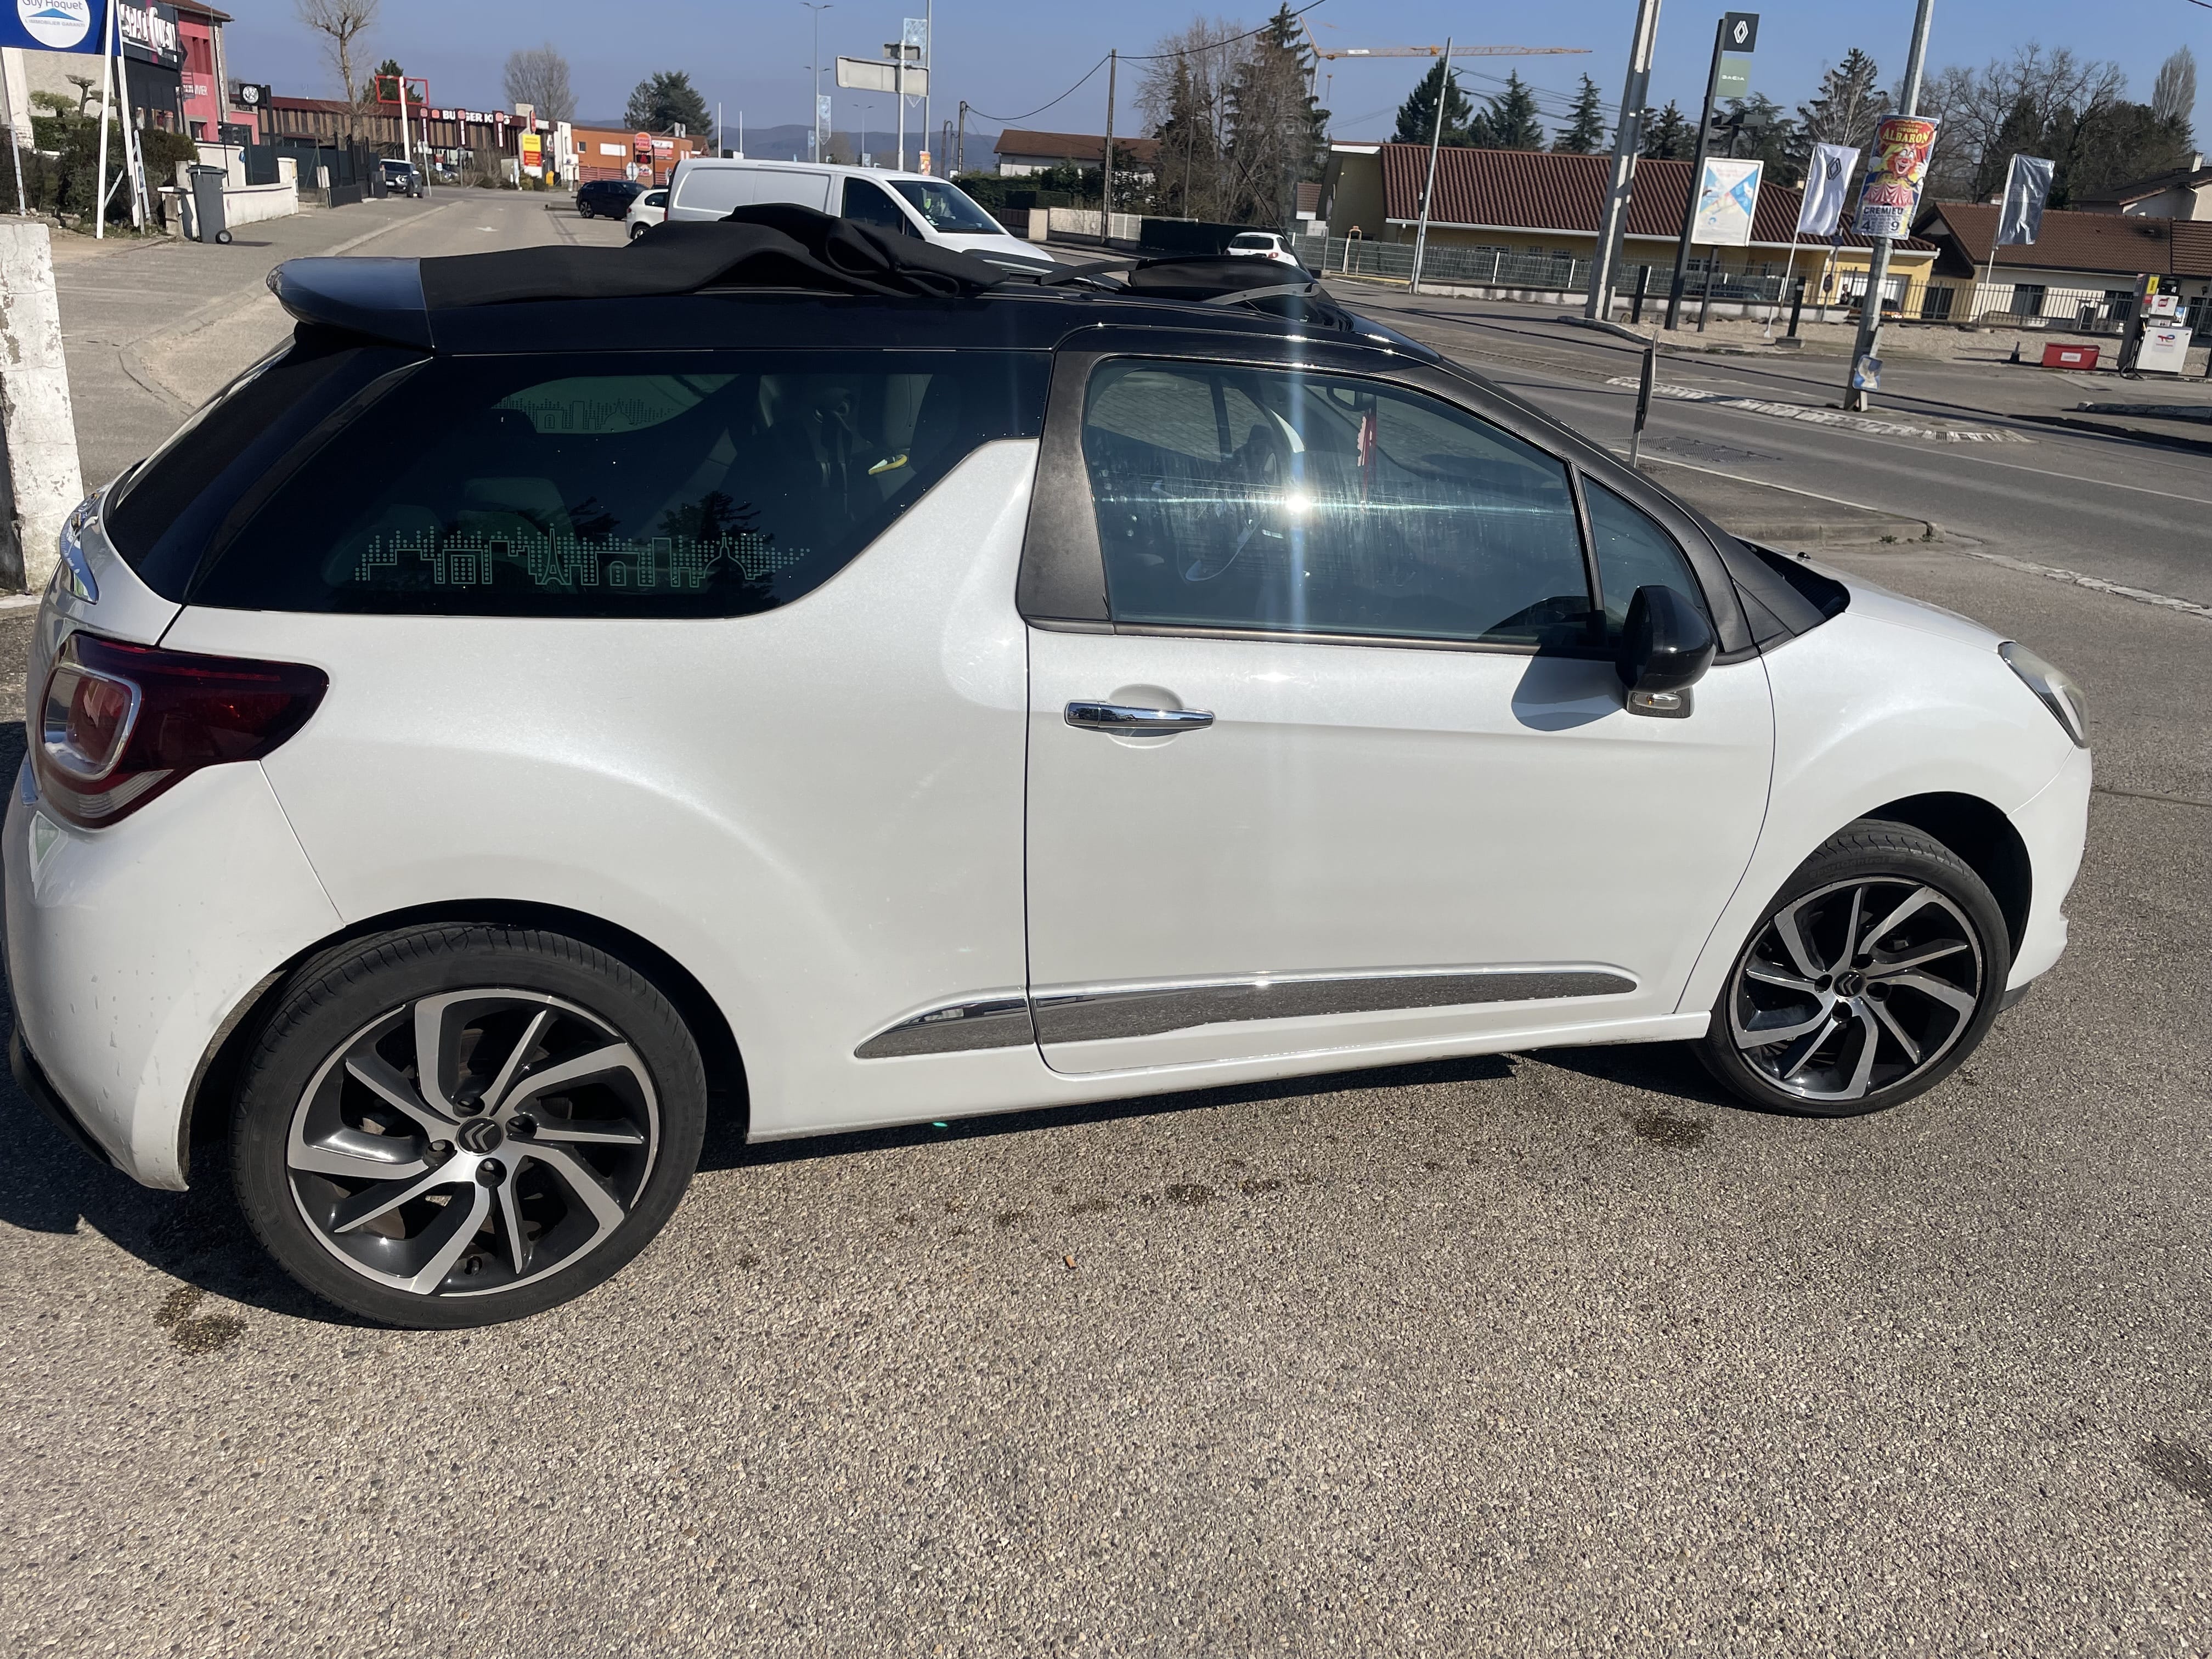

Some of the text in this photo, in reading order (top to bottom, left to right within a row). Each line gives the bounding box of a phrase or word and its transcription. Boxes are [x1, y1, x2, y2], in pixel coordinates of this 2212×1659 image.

[22, 0, 83, 10] Guy Hoquet
[442, 110, 510, 125] BUGER KIG
[1882, 127, 1931, 144] ALBARON
[1864, 206, 1904, 215] CREMIEU
[1891, 221, 1899, 231] 9
